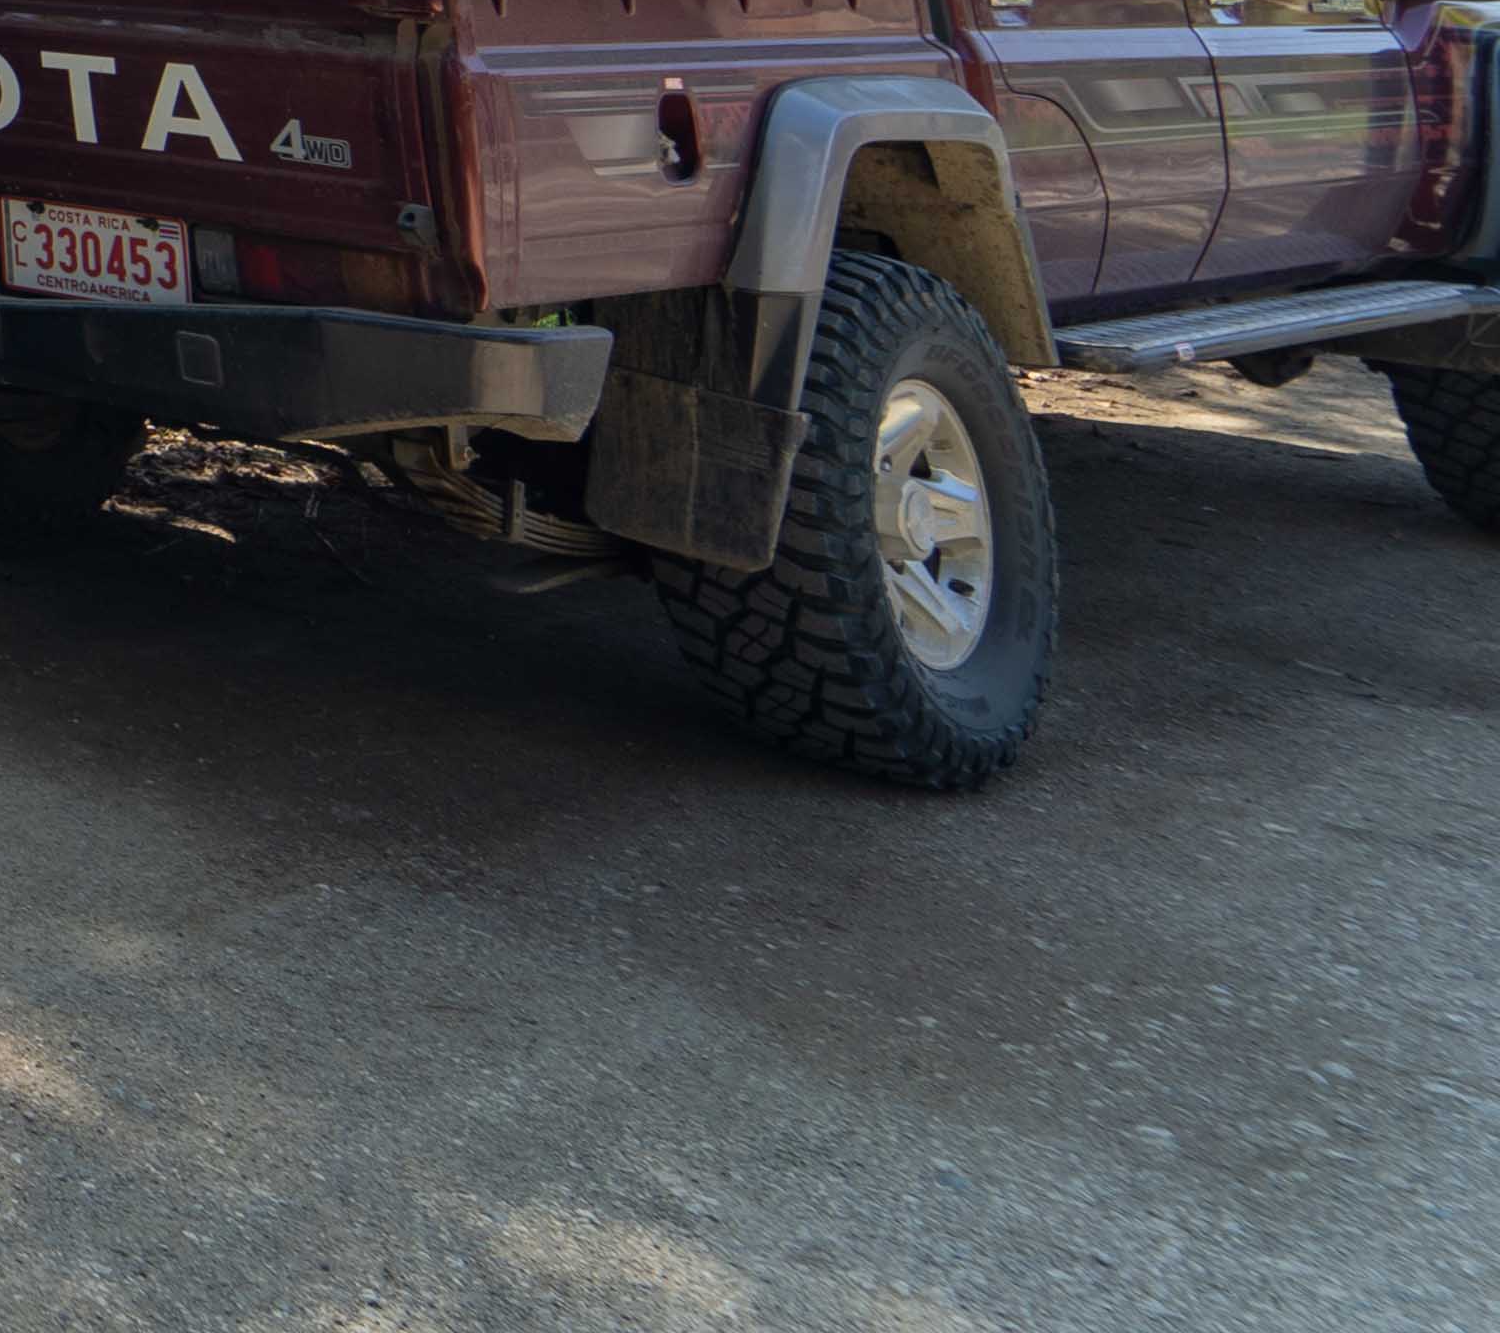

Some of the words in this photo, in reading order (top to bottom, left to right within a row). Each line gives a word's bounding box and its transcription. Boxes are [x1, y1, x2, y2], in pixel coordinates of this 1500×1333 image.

[269, 119, 352, 167] 4WD
[48, 208, 92, 225] COSTA
[99, 214, 131, 231] RICA
[33, 223, 179, 290] 330453
[36, 273, 152, 302] CENTROAMERICA
